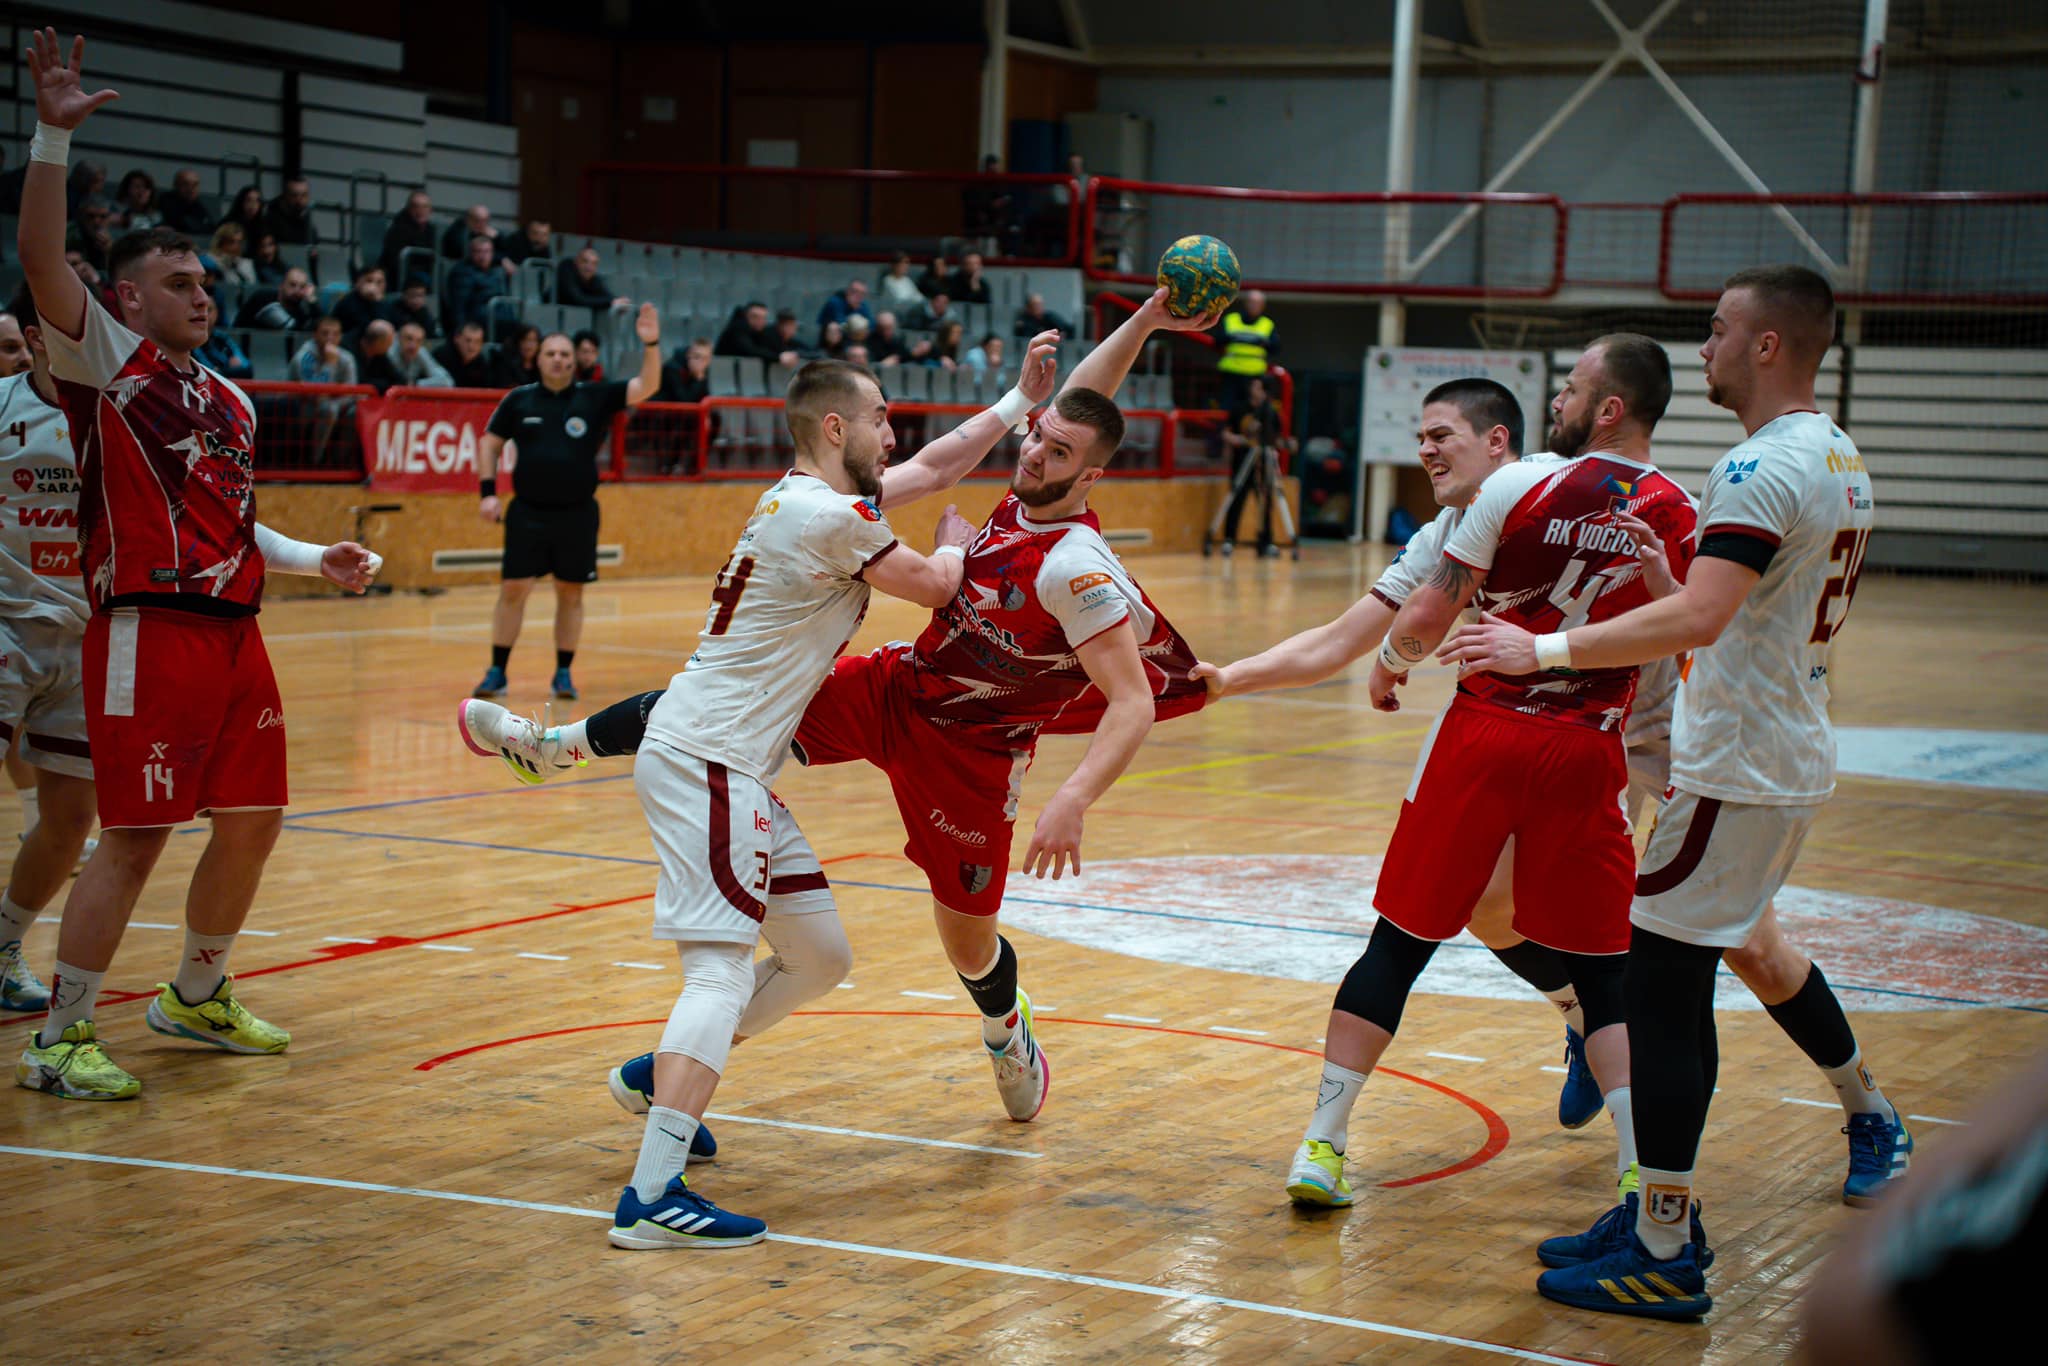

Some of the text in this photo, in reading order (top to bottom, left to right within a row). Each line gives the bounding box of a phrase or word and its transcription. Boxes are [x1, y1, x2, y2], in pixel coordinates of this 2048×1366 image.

[10, 421, 26, 447] 4
[34, 468, 74, 480] VISIT
[1543, 518, 1577, 546] RK
[142, 763, 174, 802] 14
[929, 808, 987, 846] Dolcetto
